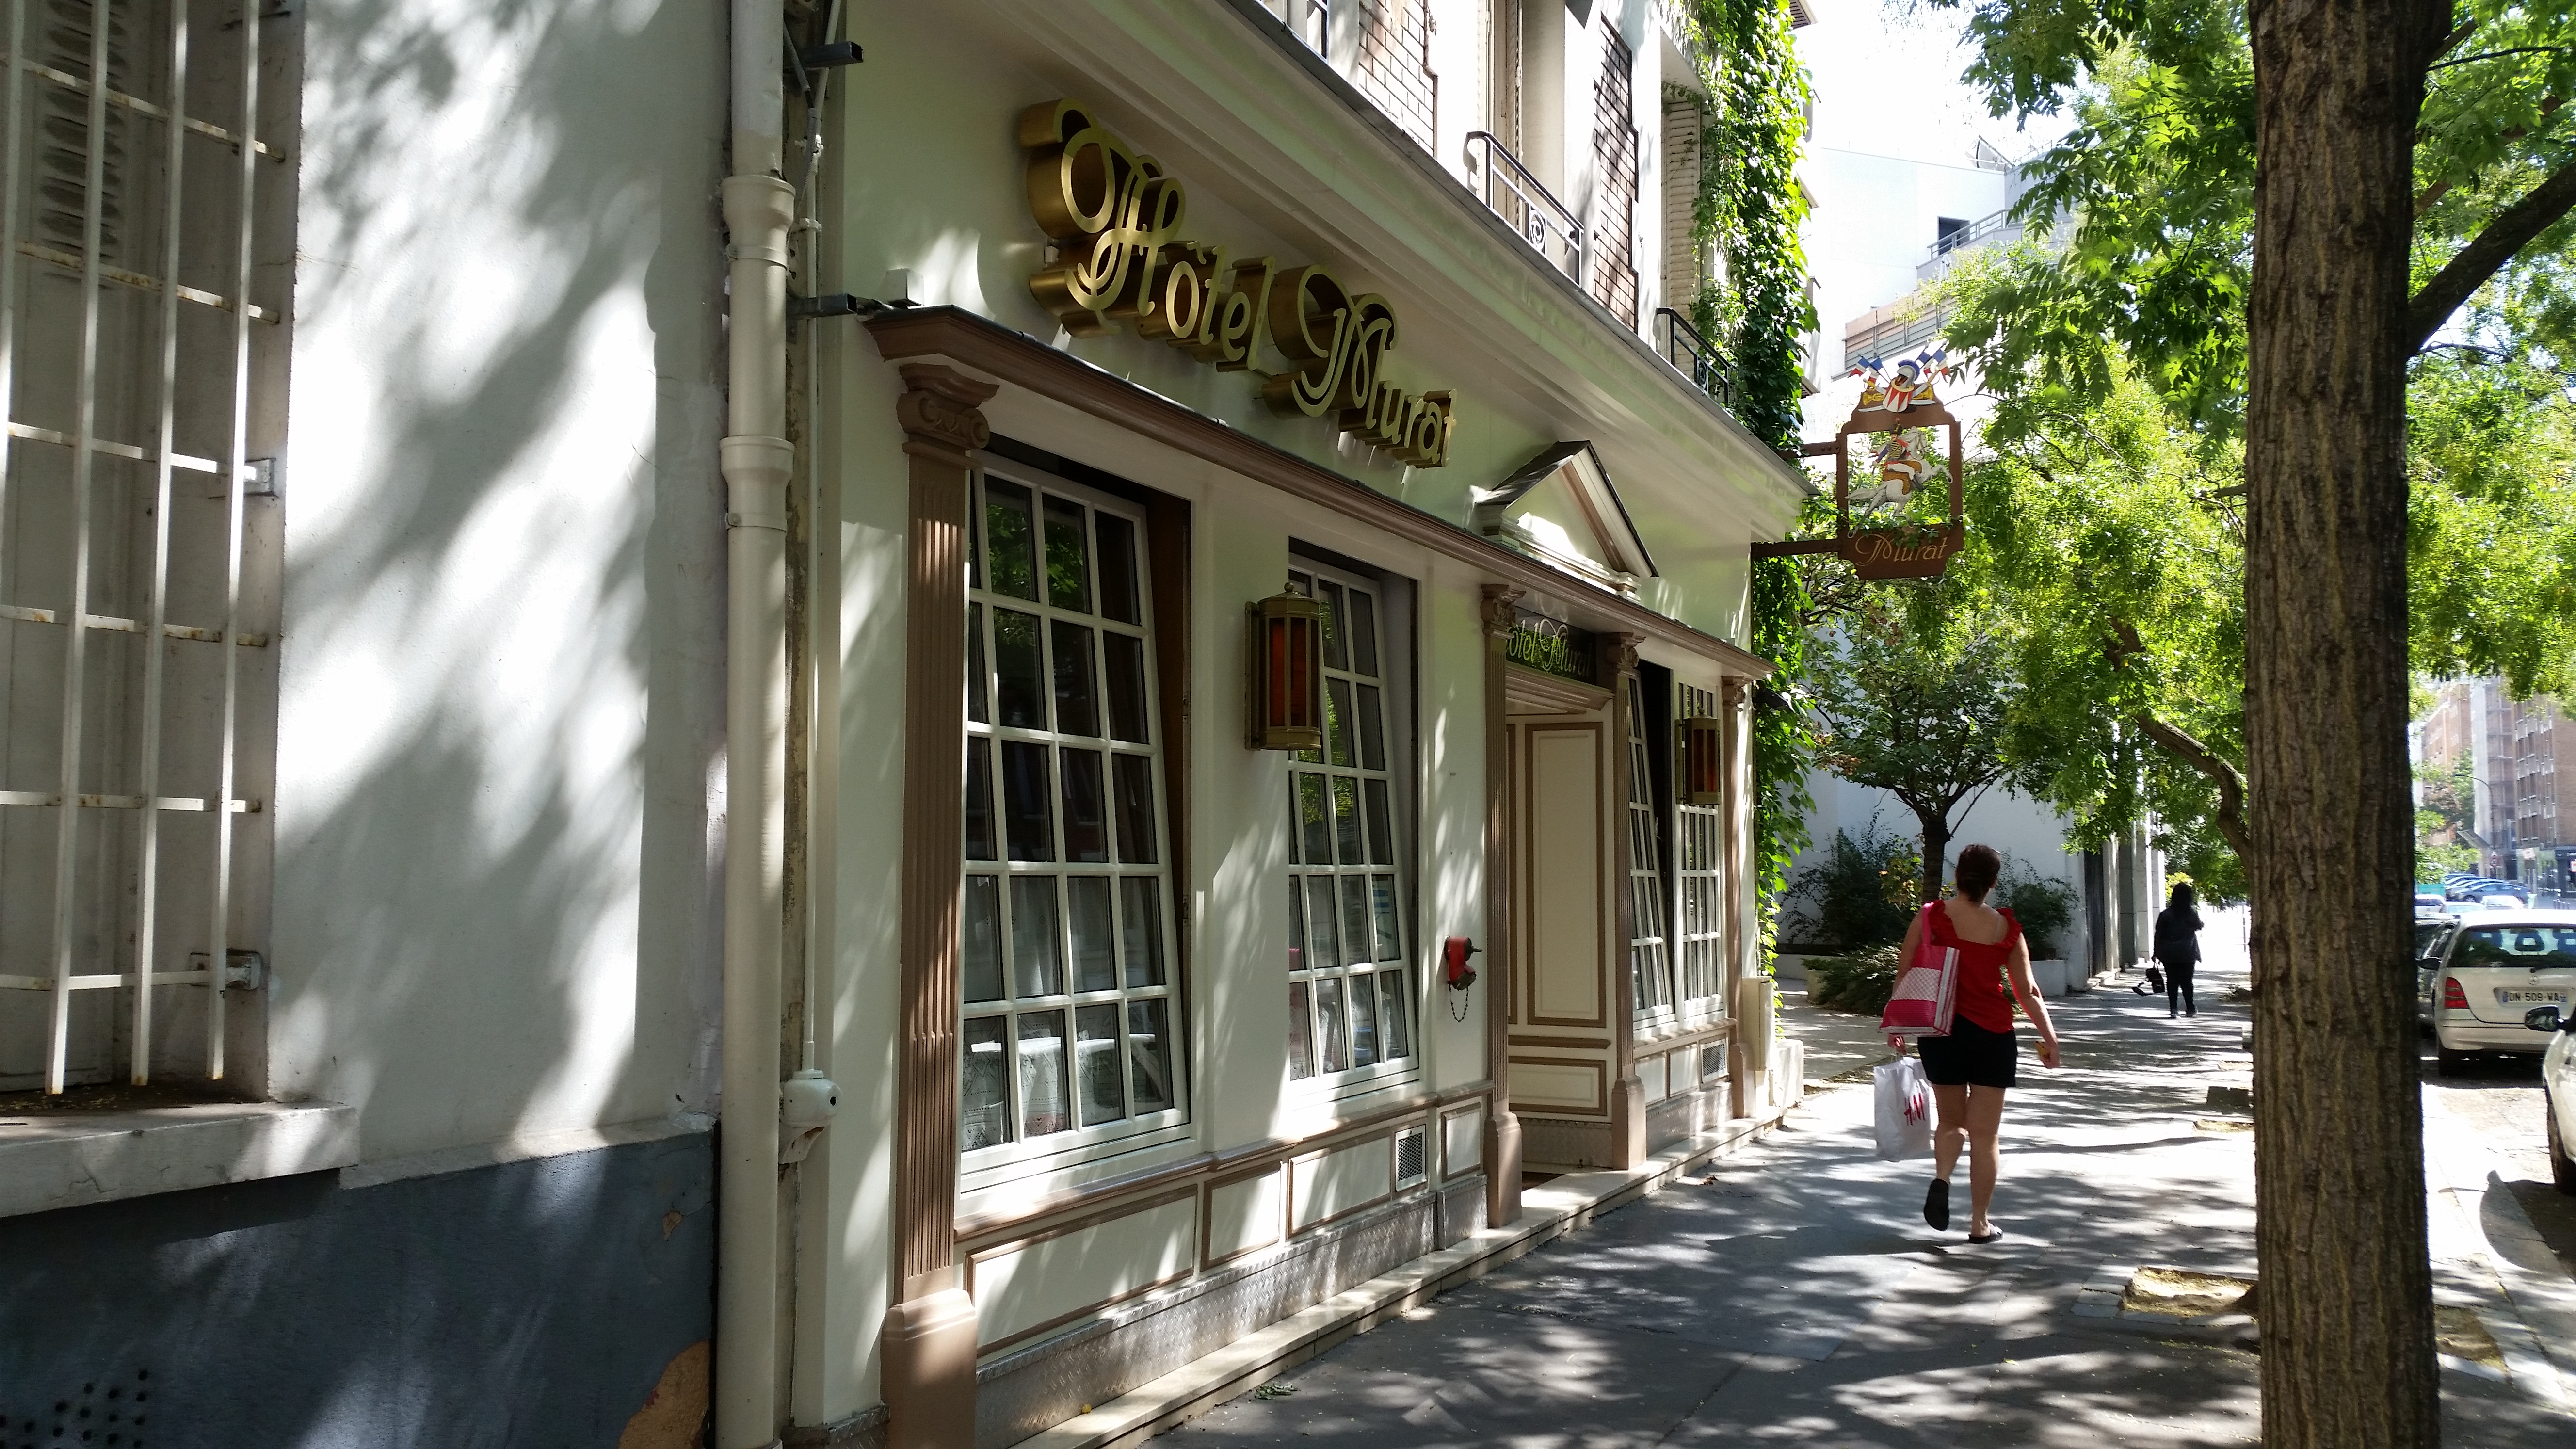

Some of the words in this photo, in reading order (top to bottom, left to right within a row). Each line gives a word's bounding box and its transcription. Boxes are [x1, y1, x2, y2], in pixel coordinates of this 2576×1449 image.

[1291, 264, 1458, 467] Murat
[1855, 533, 1948, 566] Murat
[1506, 619, 1539, 662] ôtel
